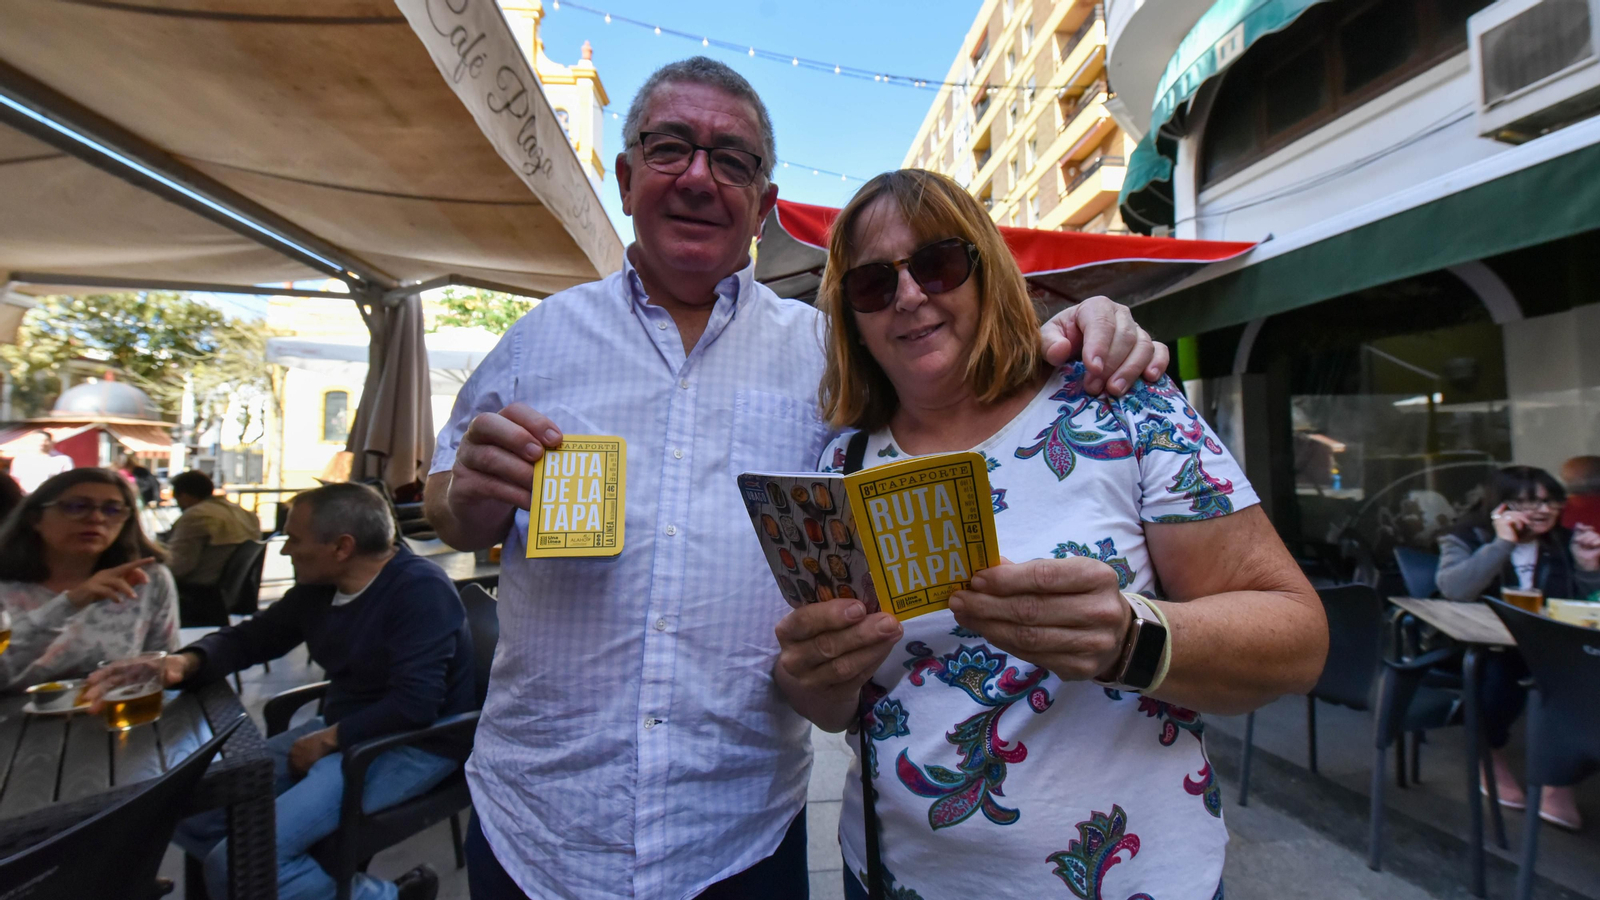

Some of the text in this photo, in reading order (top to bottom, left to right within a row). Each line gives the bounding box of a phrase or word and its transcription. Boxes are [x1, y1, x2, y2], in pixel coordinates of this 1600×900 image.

[425, 0, 553, 179] Café Plaza
[545, 452, 602, 477] RUTA
[878, 466, 969, 490] TAPAPORTE
[543, 478, 602, 503] DE LA
[542, 504, 600, 531] TAPA
[868, 484, 956, 532] RUTA
[878, 520, 962, 564] DE LA
[966, 524, 978, 534] 4€
[887, 551, 968, 594] TAPA
